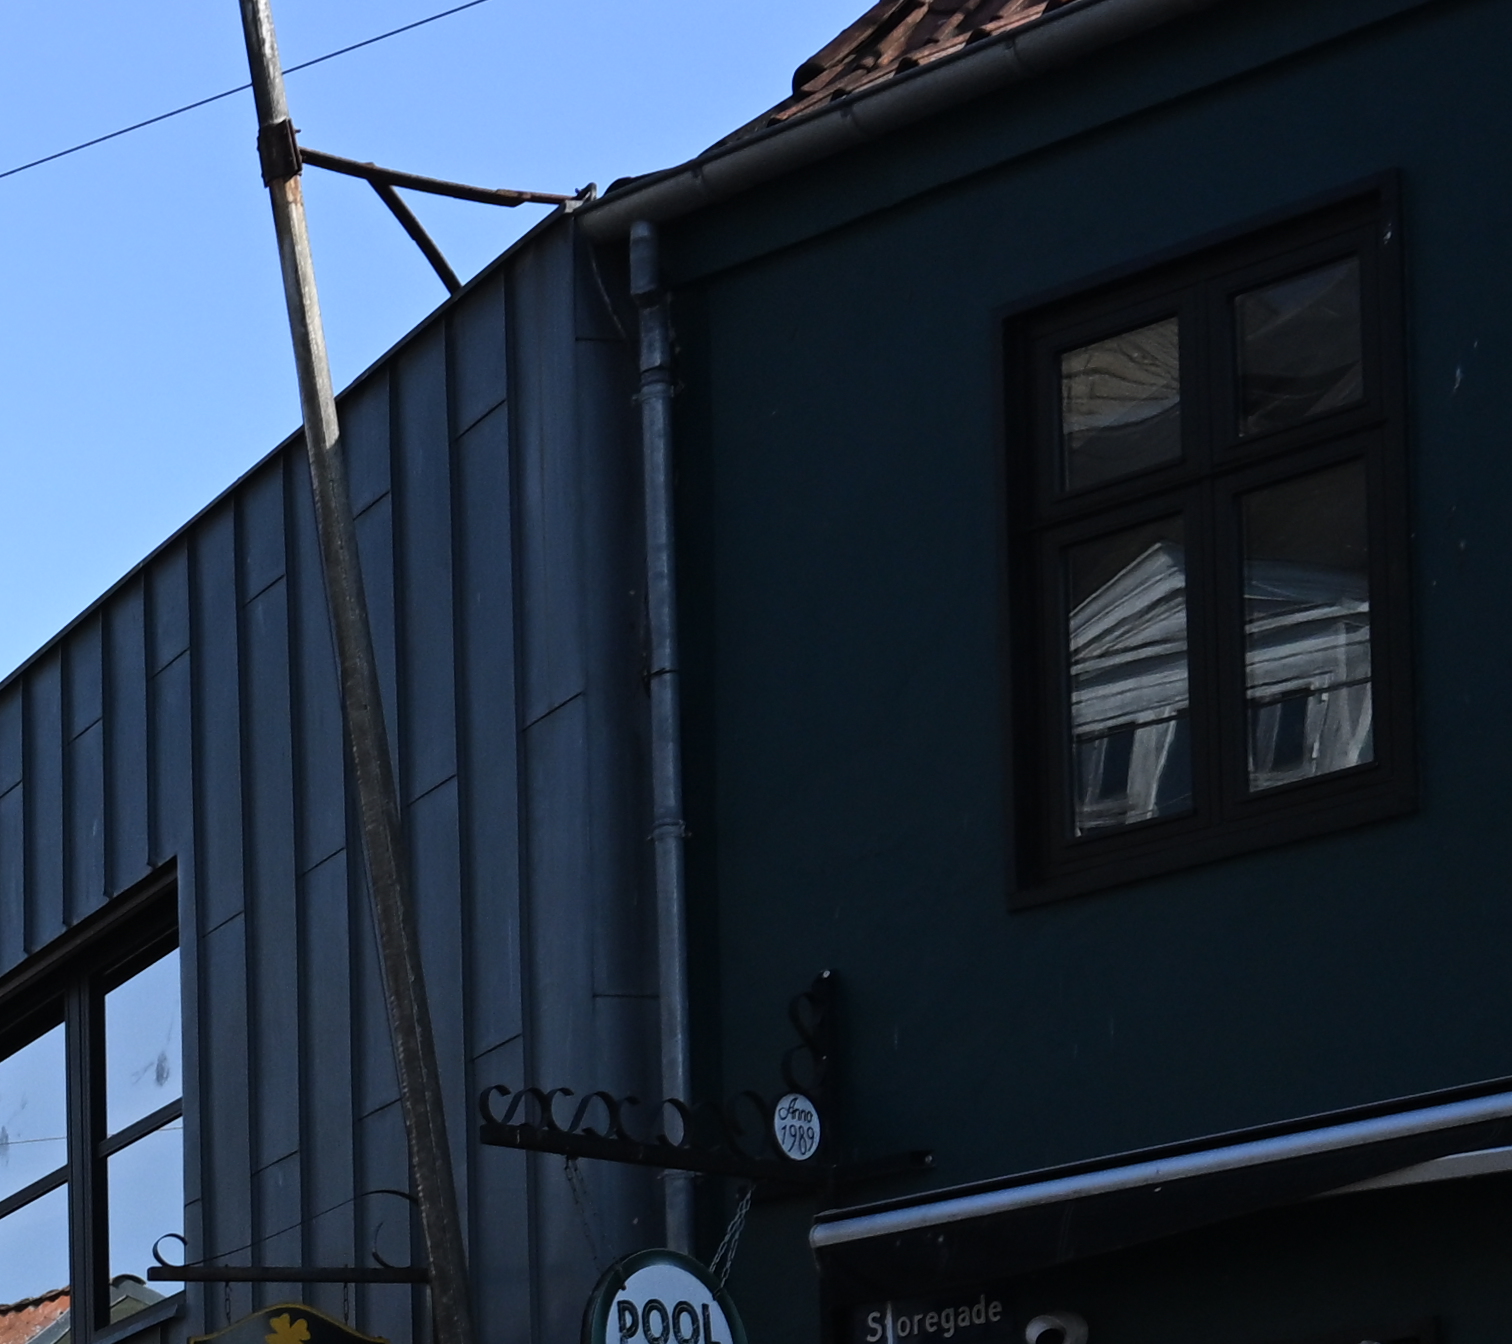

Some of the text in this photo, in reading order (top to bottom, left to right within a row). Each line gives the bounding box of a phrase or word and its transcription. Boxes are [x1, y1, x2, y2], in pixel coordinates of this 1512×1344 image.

[778, 1097, 813, 1123] Anno
[781, 1124, 815, 1156] 1989
[866, 1293, 1003, 1343] Soregade
